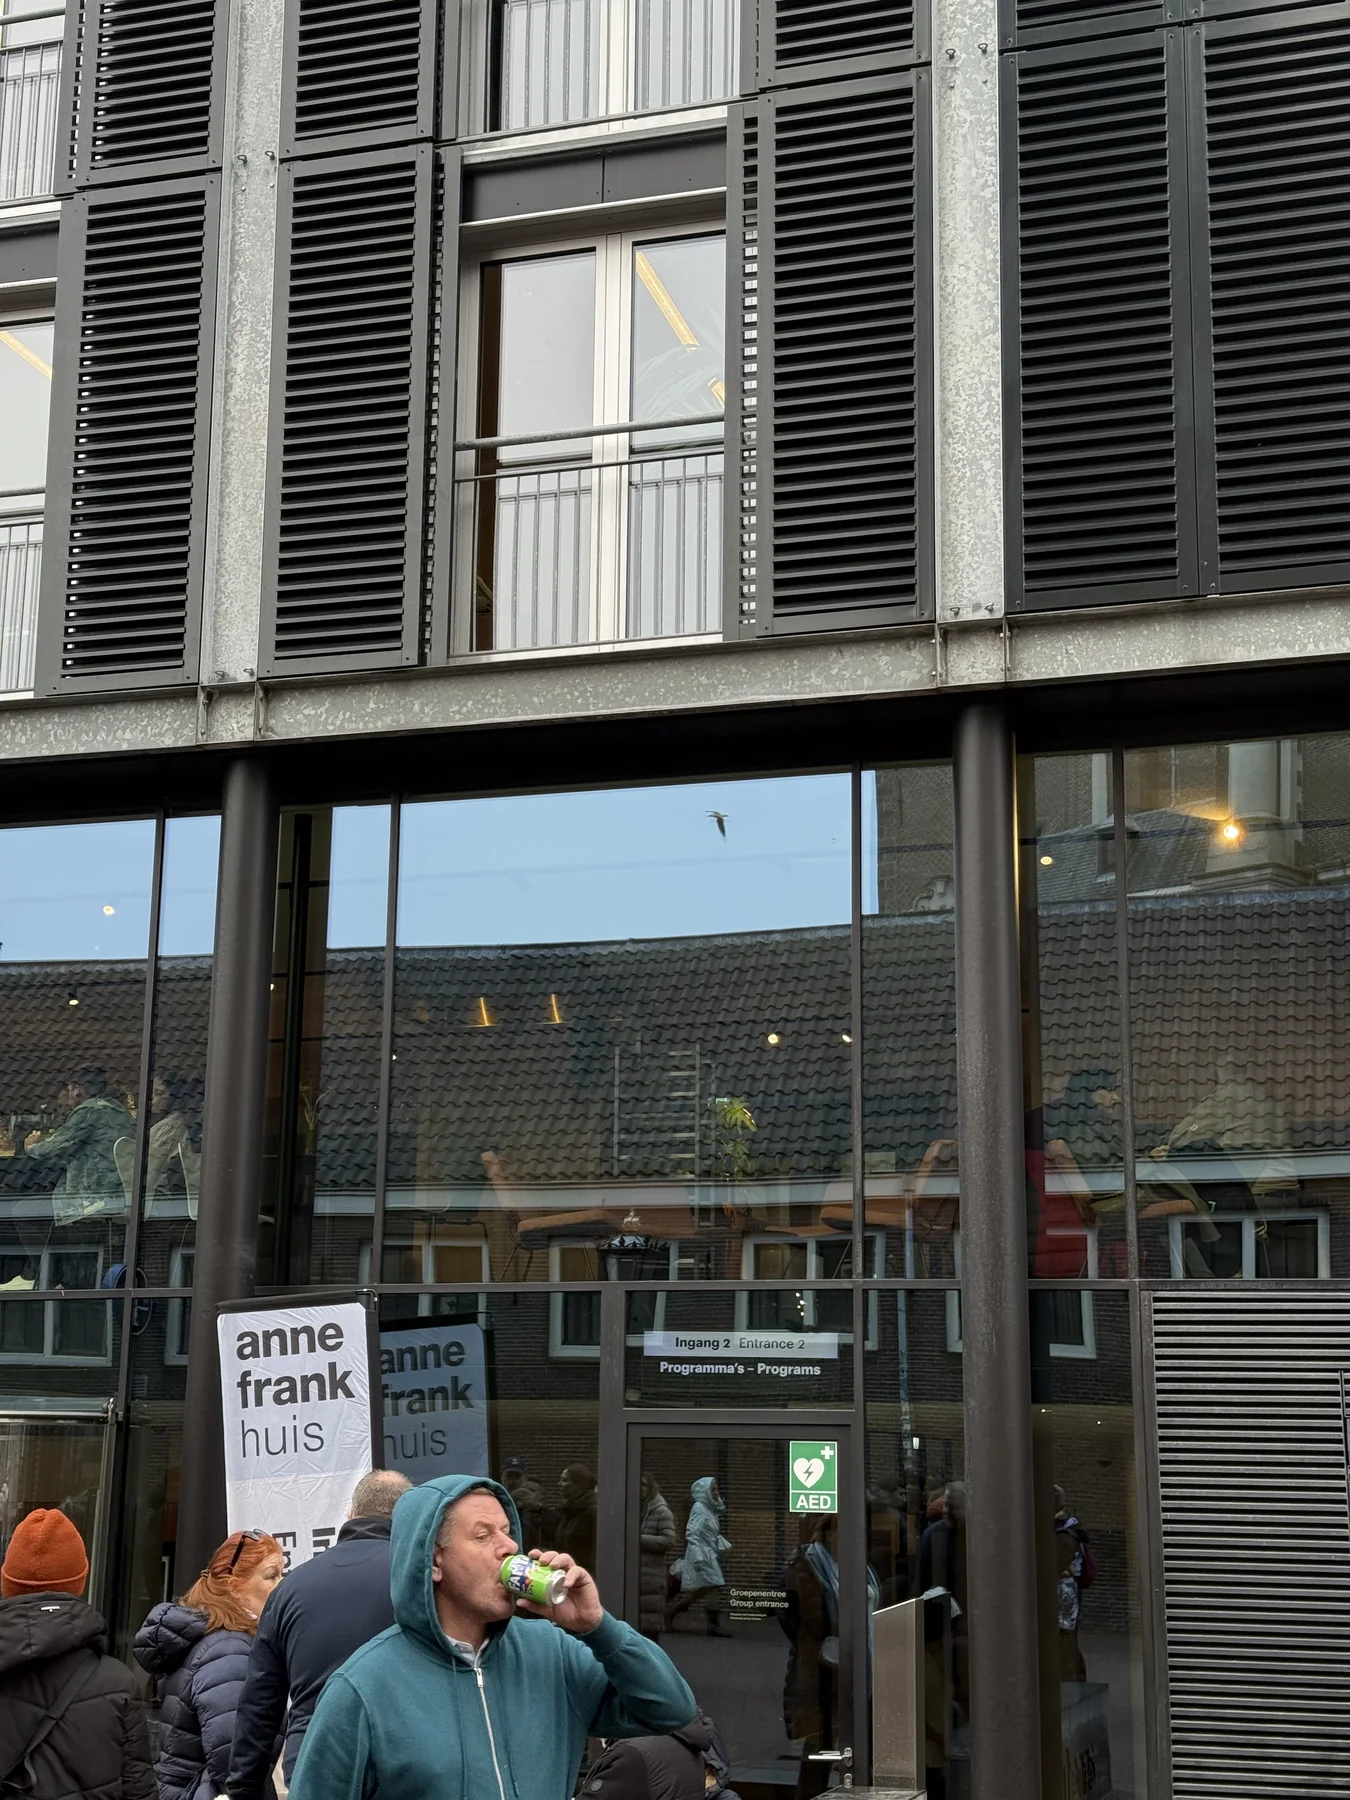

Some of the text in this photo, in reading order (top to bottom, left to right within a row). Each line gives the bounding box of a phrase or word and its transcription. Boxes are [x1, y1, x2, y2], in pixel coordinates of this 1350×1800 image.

[236, 1322, 344, 1361] anne
[675, 1337, 805, 1350] Ingang 2 Entrance 2
[380, 1340, 466, 1375] anne
[659, 1361, 745, 1376] Programma's
[757, 1362, 821, 1377] Programs
[236, 1362, 355, 1409] frank
[240, 1415, 324, 1458] huis
[796, 1495, 831, 1509] AED
[730, 1588, 787, 1597] Groepenentree
[730, 1599, 789, 1608] Group entrance
